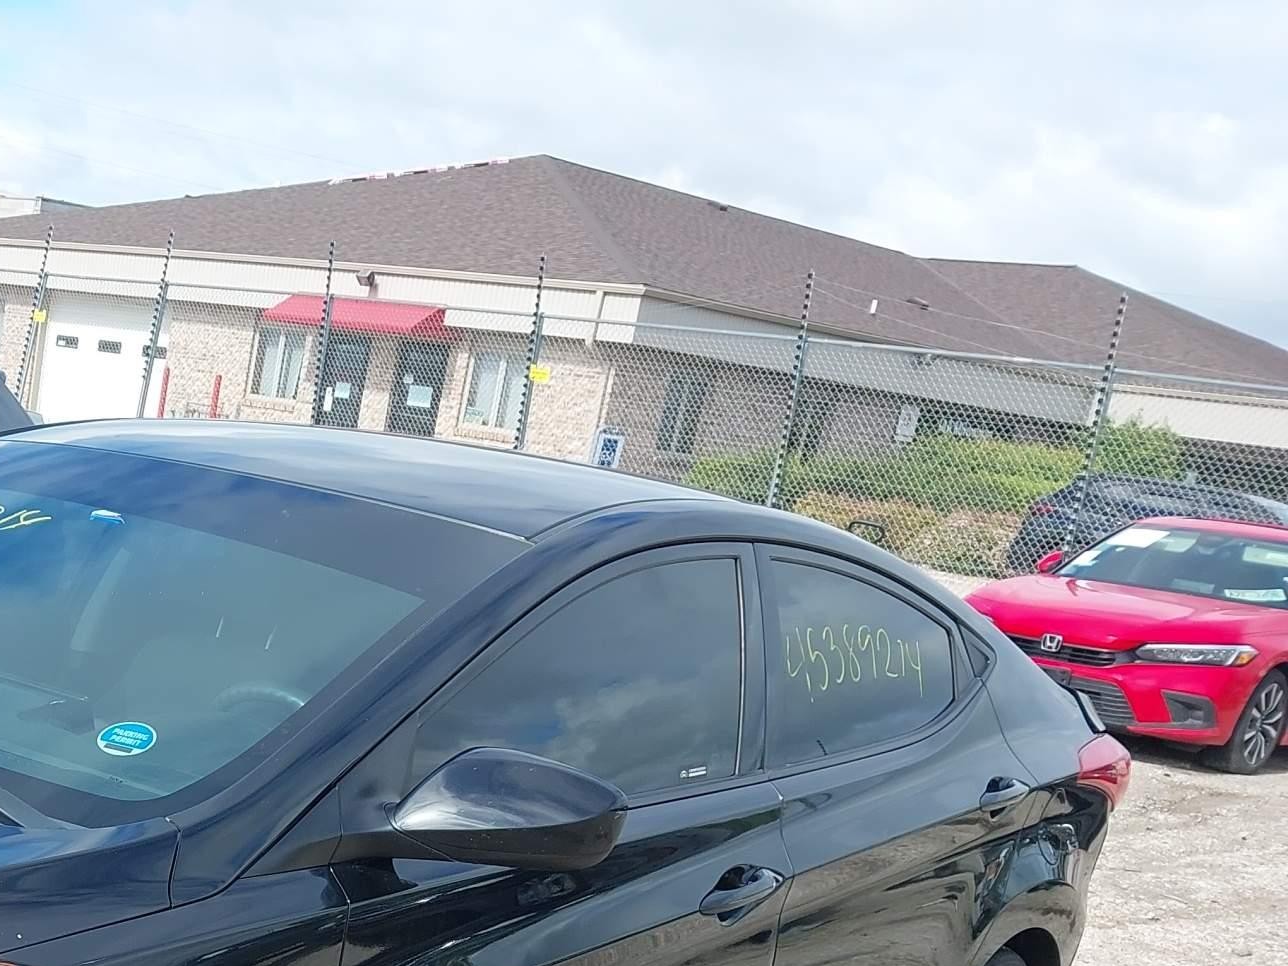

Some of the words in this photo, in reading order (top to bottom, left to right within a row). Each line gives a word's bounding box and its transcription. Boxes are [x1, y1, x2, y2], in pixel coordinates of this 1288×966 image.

[786, 623, 924, 703] 45389214
[108, 734, 142, 746] PERMIT
[112, 727, 150, 741] PARKING
